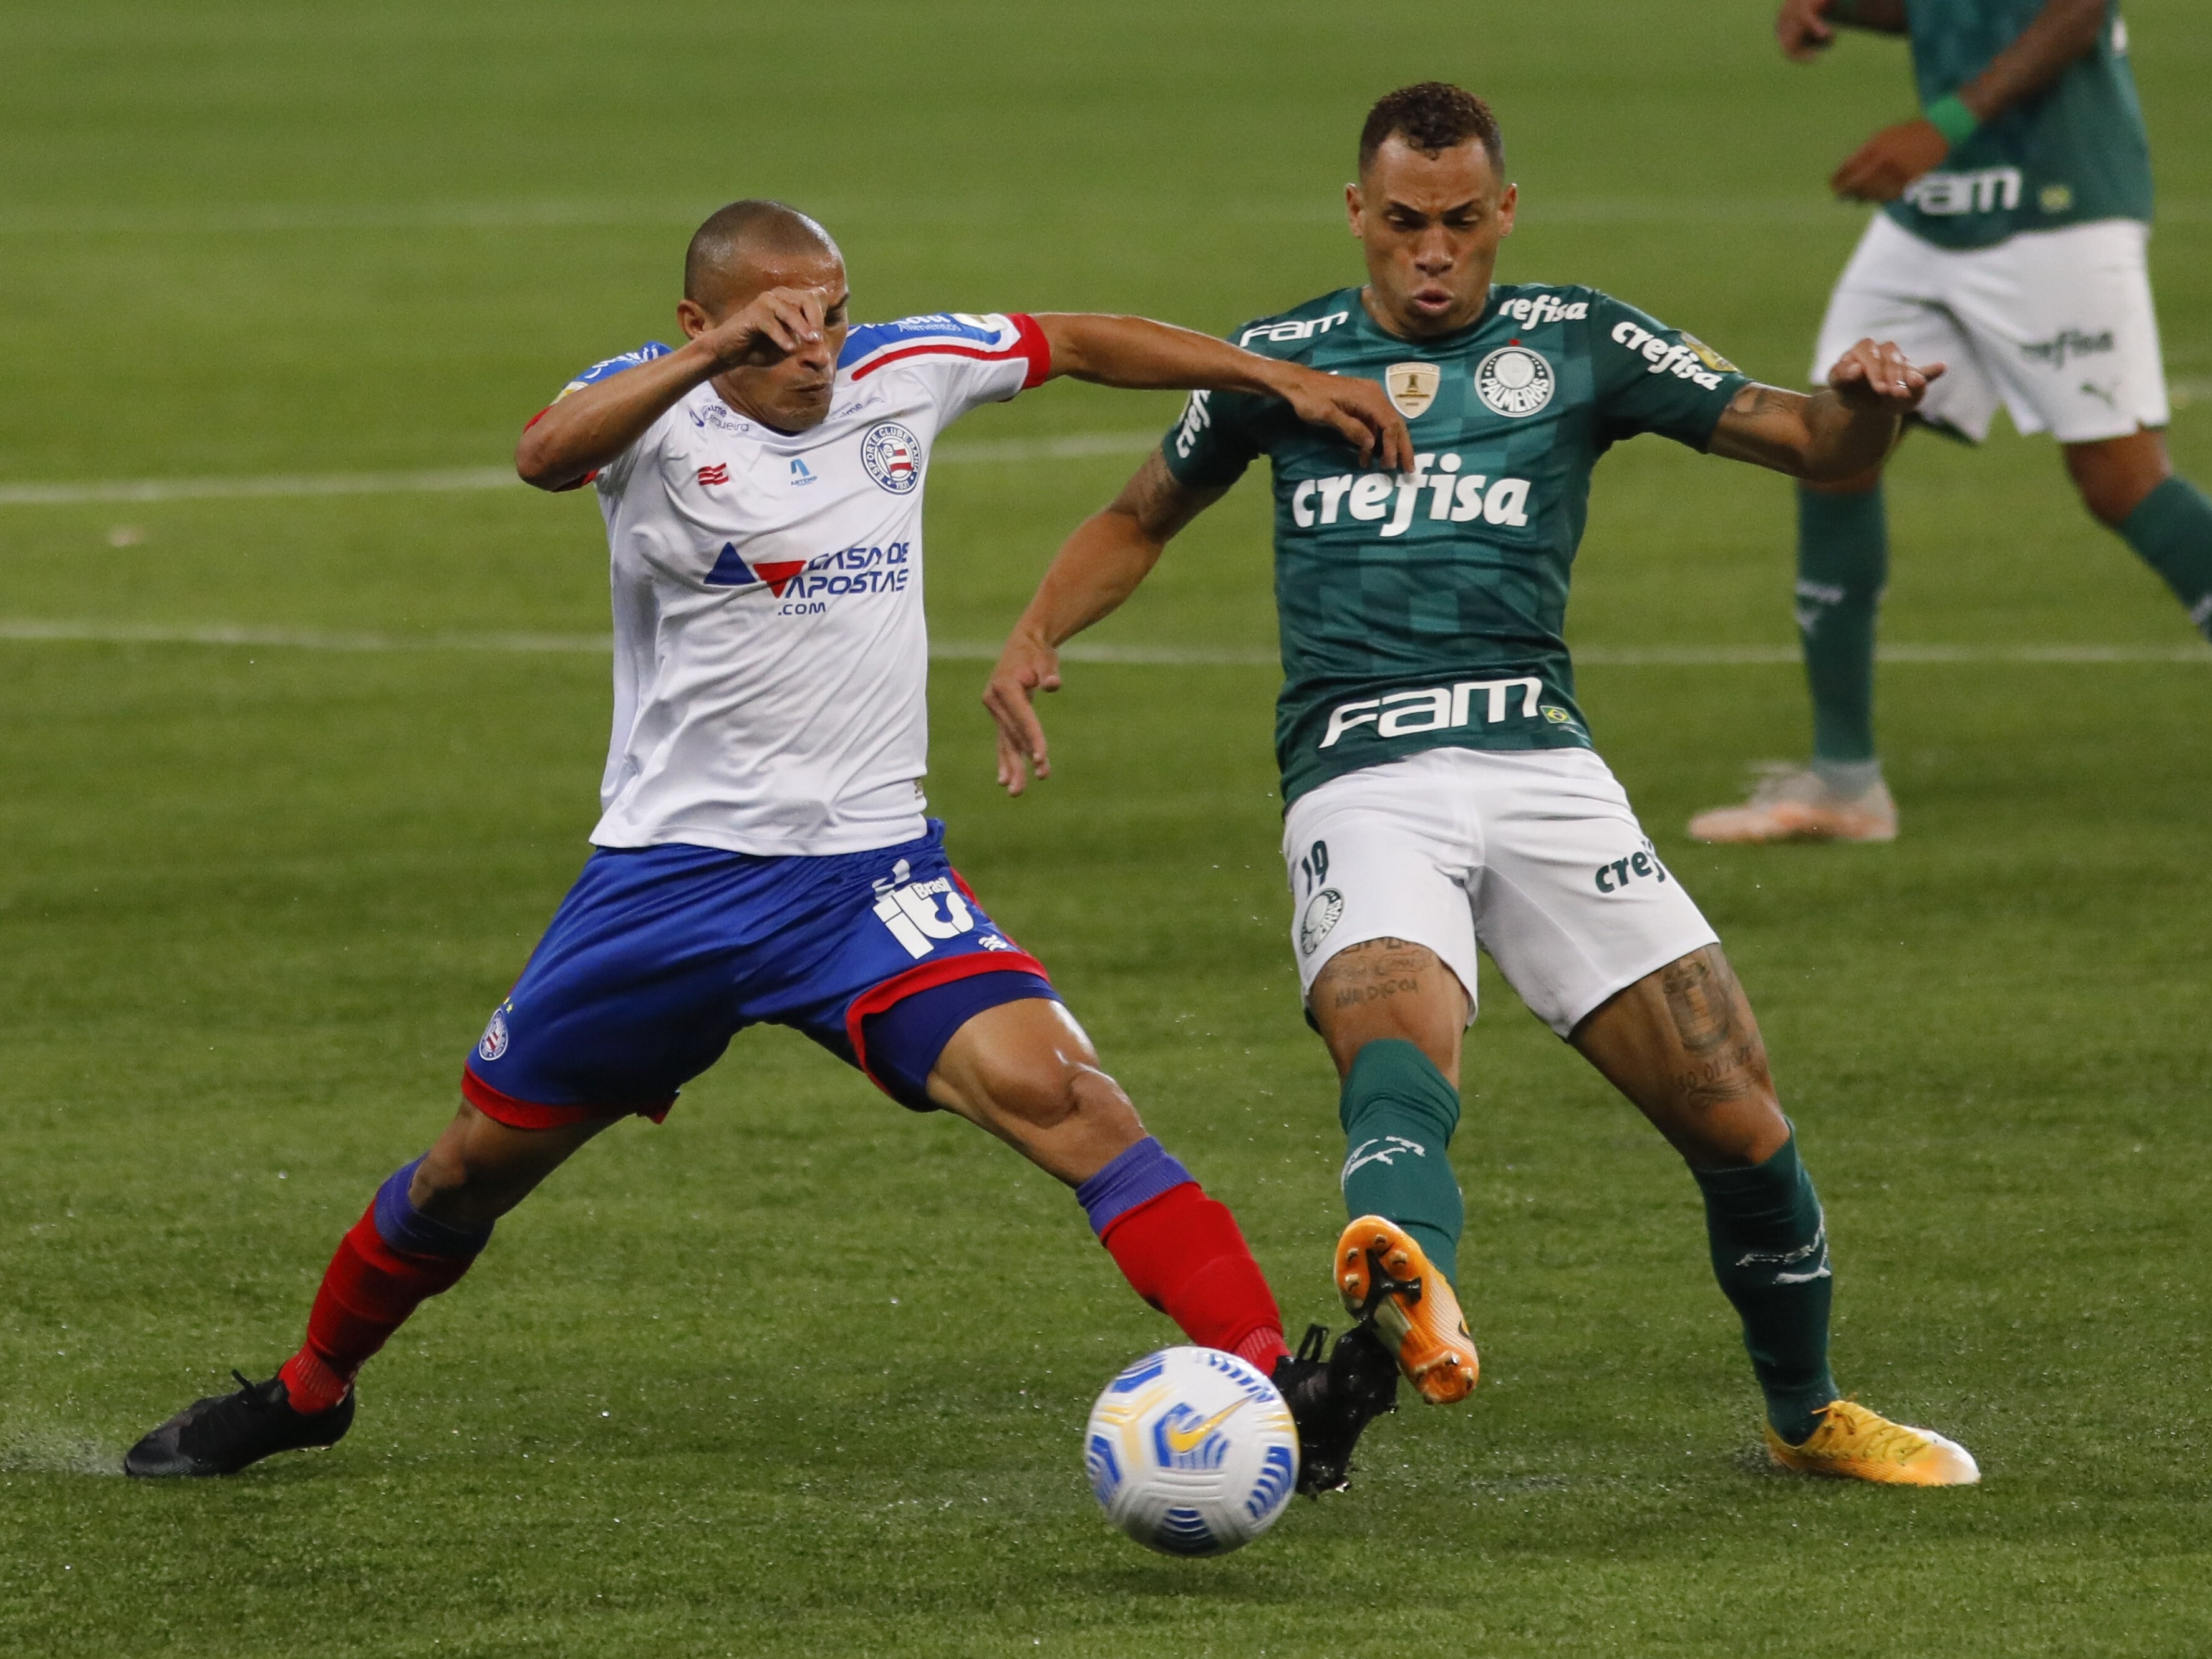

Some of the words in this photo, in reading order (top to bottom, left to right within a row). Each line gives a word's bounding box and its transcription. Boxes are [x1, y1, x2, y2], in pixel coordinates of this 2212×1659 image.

[898, 322, 962, 332] Alimentos
[1498, 294, 1590, 331] refisa
[1611, 321, 1723, 391] crefisa
[1482, 377, 1549, 412] PALMEIRAS
[1176, 389, 1212, 459] cref
[866, 434, 884, 480] ESPORTE
[878, 427, 909, 442] CLUBE
[1292, 453, 1532, 537] crefisa
[808, 546, 882, 571] CASA
[785, 569, 909, 599] APOSTAS
[778, 602, 826, 616] .COM
[1302, 839, 1330, 896] 19
[911, 877, 952, 900] Brasil
